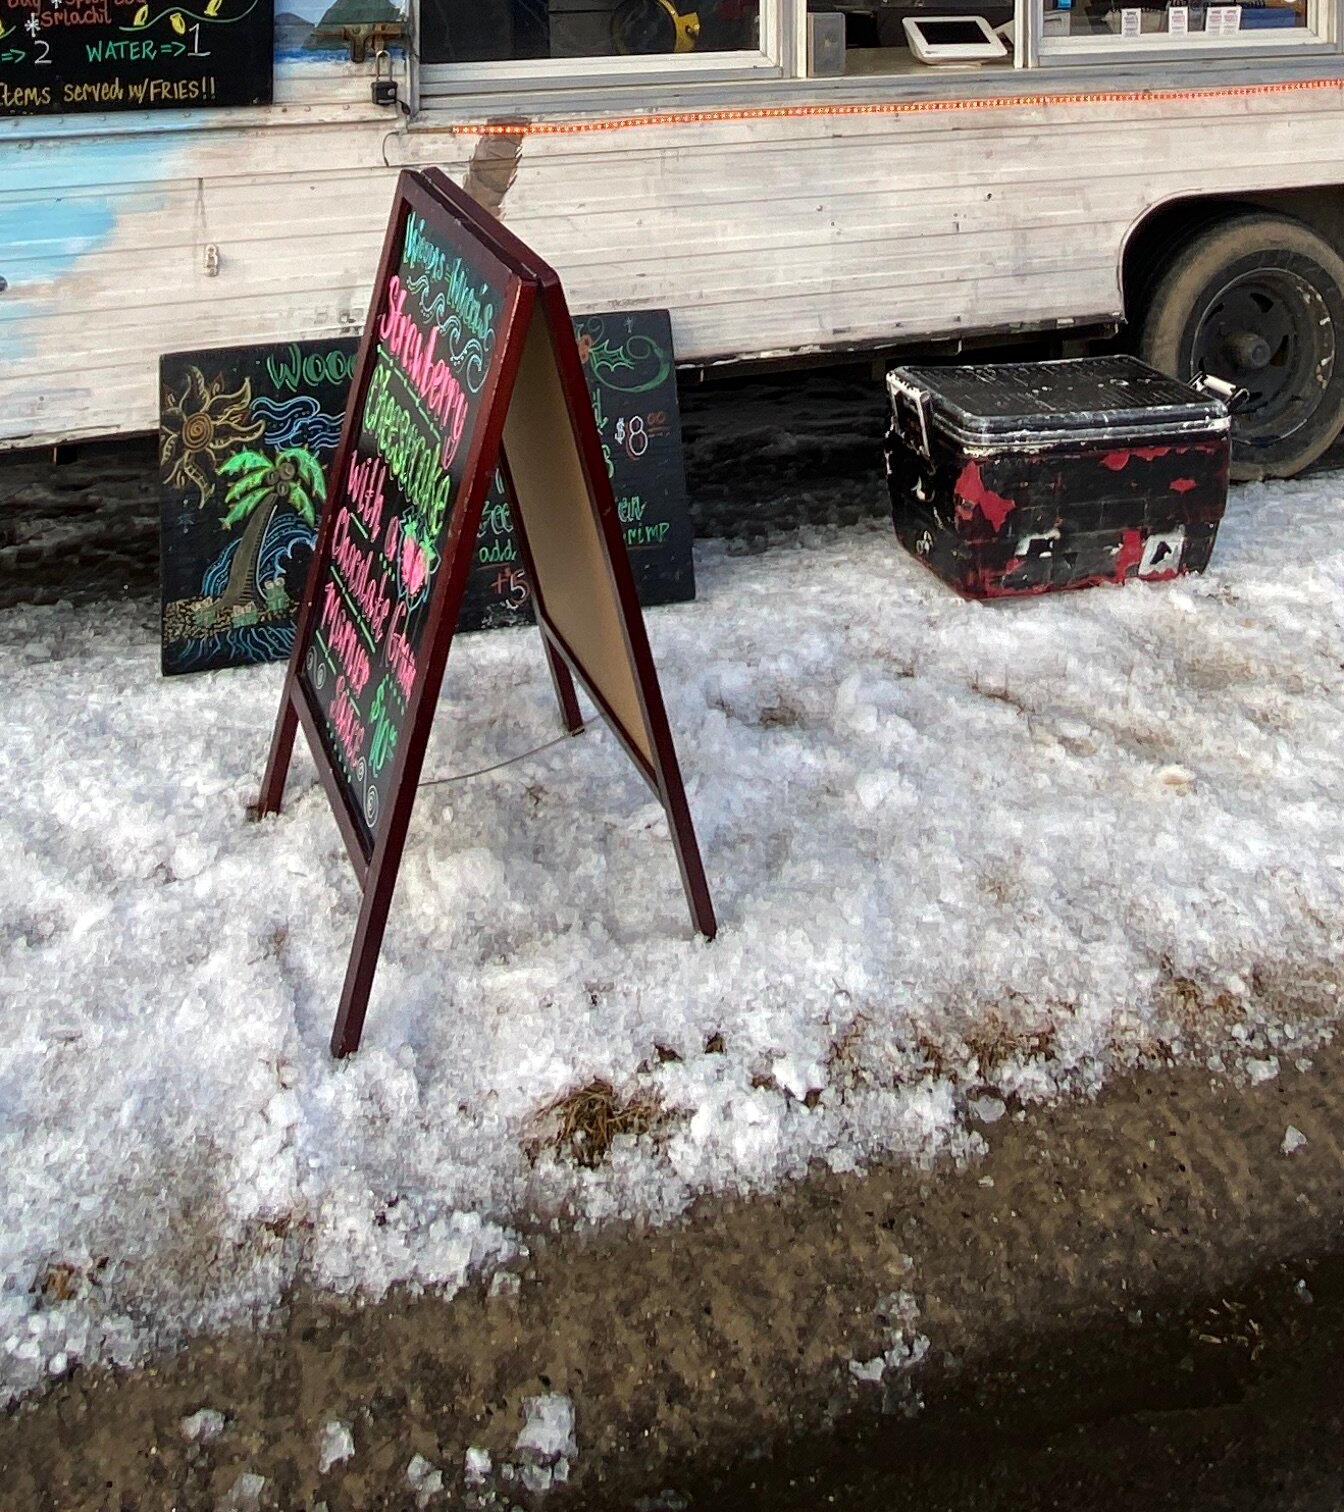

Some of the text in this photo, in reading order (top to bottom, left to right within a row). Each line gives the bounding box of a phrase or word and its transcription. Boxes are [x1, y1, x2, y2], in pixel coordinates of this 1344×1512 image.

[33, 39, 53, 65] 2
[85, 40, 158, 63] WATER
[186, 22, 211, 57] 1
